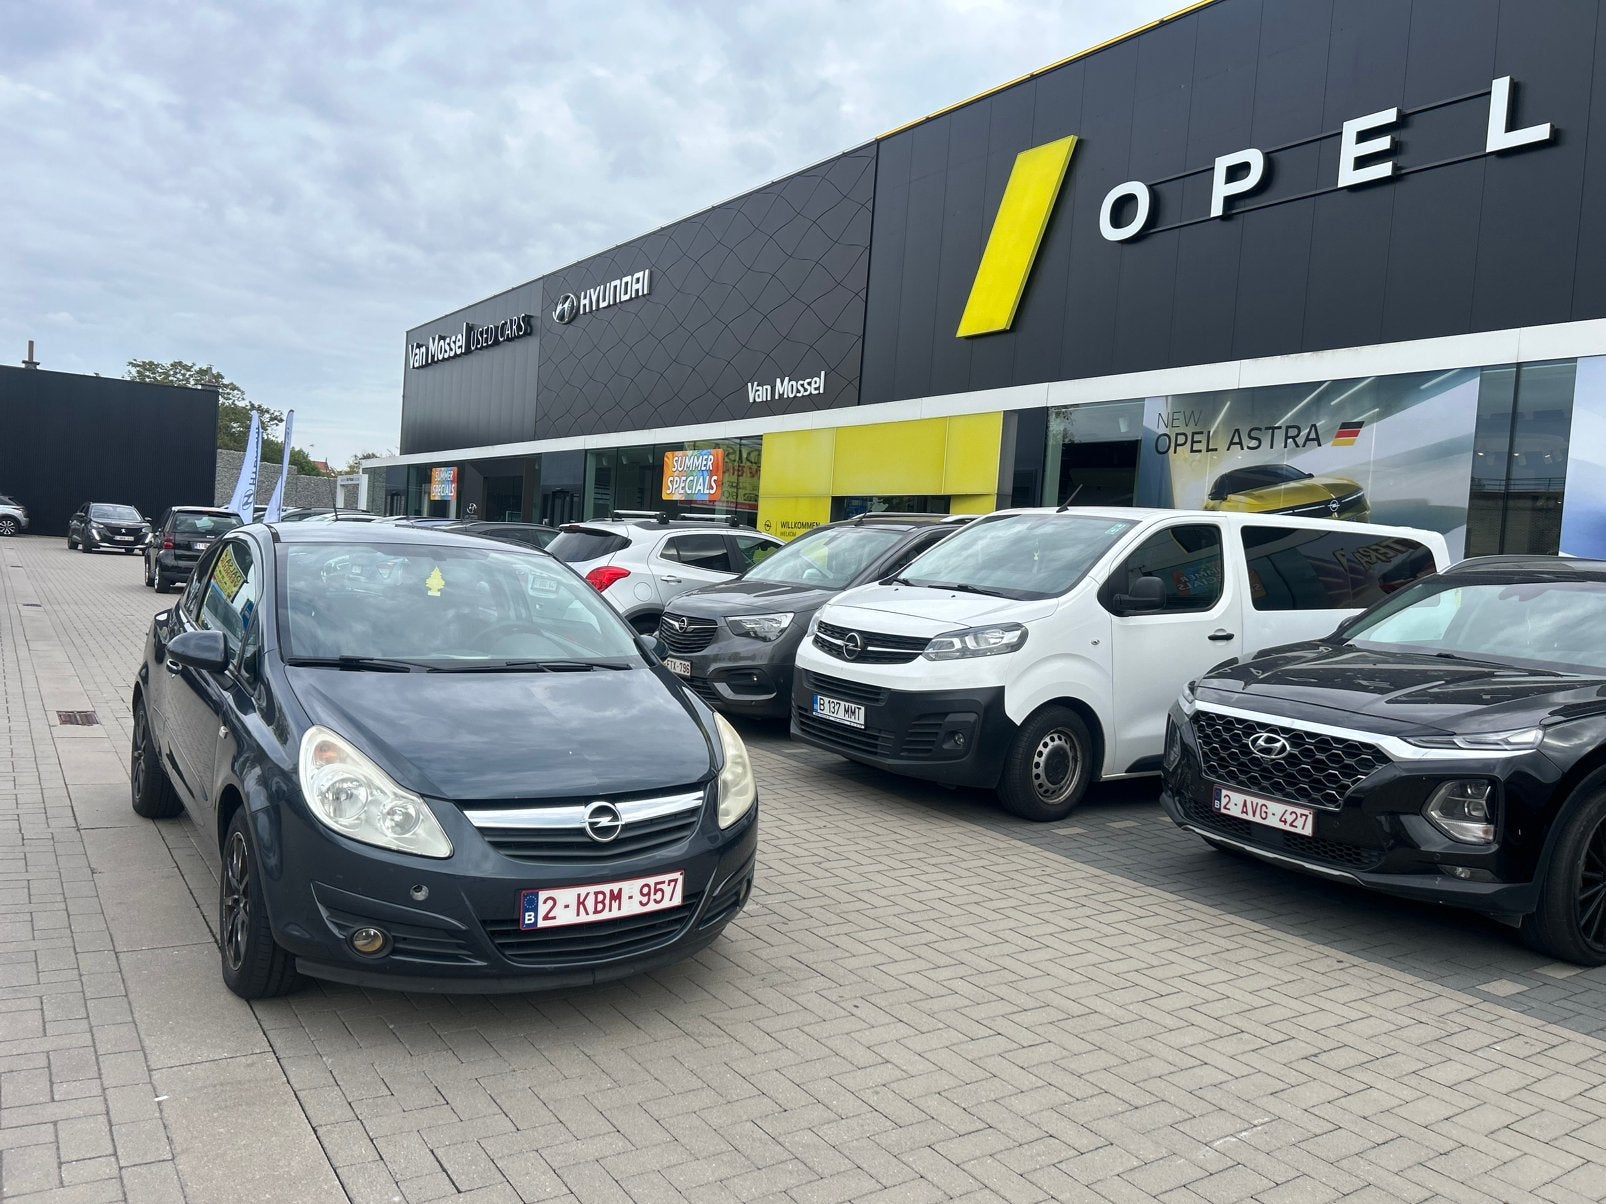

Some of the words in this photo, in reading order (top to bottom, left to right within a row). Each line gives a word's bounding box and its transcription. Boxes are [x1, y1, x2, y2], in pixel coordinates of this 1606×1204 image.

[1099, 75, 1555, 242] OPEL
[579, 269, 650, 315] HYUNDAI
[408, 341, 427, 369] Van
[428, 322, 467, 364] Mossel
[470, 324, 495, 351] USED
[498, 313, 527, 342] CARS
[747, 382, 771, 402] Van
[775, 370, 826, 399] Mossel
[1156, 409, 1202, 429] NEW
[1154, 430, 1219, 455] OPEL
[1226, 423, 1323, 452] ASTRA
[672, 454, 714, 472] SUMMER
[666, 475, 718, 495] SPECIALS
[819, 697, 825, 711] B
[828, 700, 841, 715] 137
[843, 704, 862, 721] MMT
[1214, 800, 1220, 809] B
[1222, 794, 1309, 830] 2-AVG-427
[524, 911, 535, 924] B
[541, 877, 680, 922] 2-KBM-957
